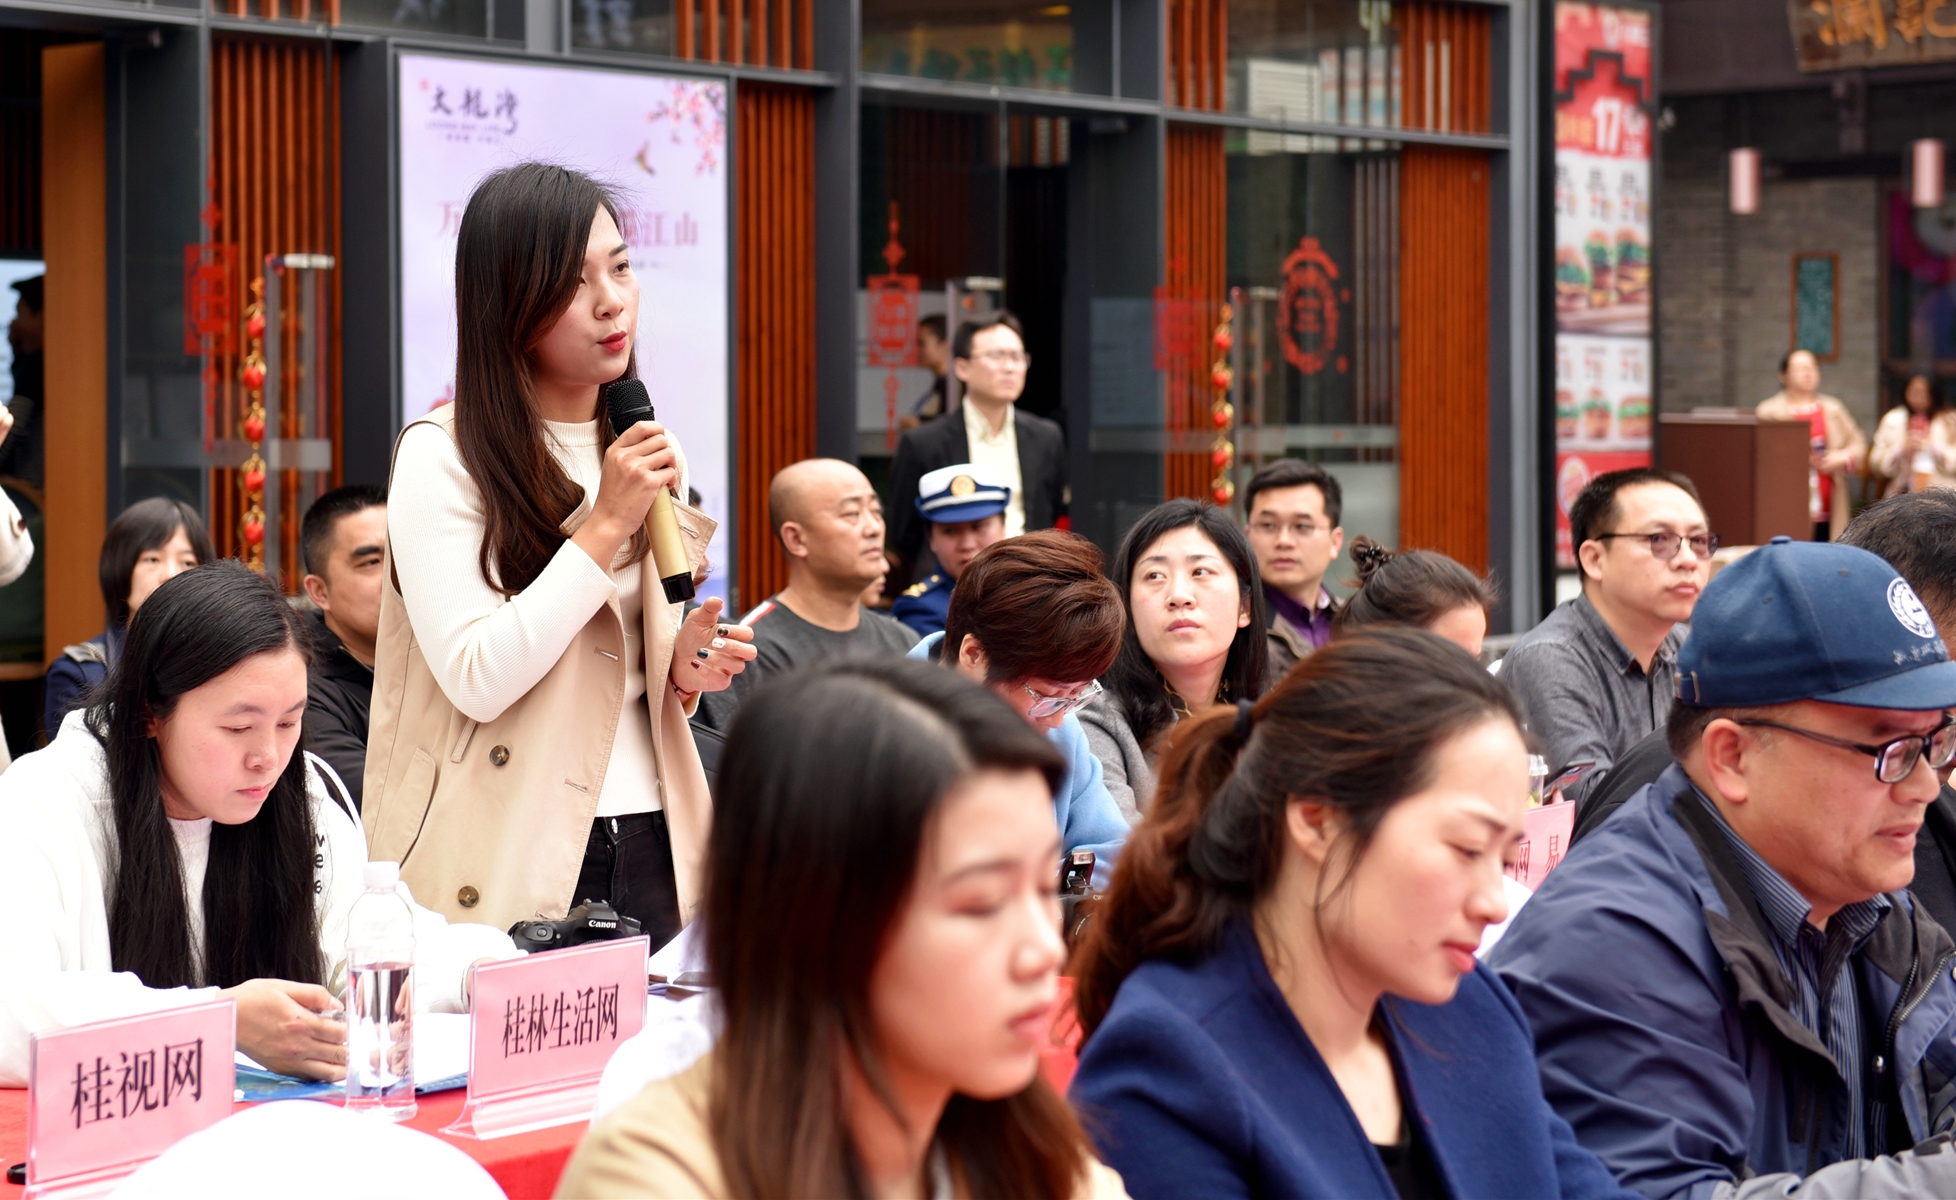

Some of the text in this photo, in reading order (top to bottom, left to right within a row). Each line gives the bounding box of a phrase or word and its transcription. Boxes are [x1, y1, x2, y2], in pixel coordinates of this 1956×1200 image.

[588, 919, 617, 929] Canon
[501, 983, 619, 1059] 桂林生活网
[69, 1036, 204, 1129] 桂视网
